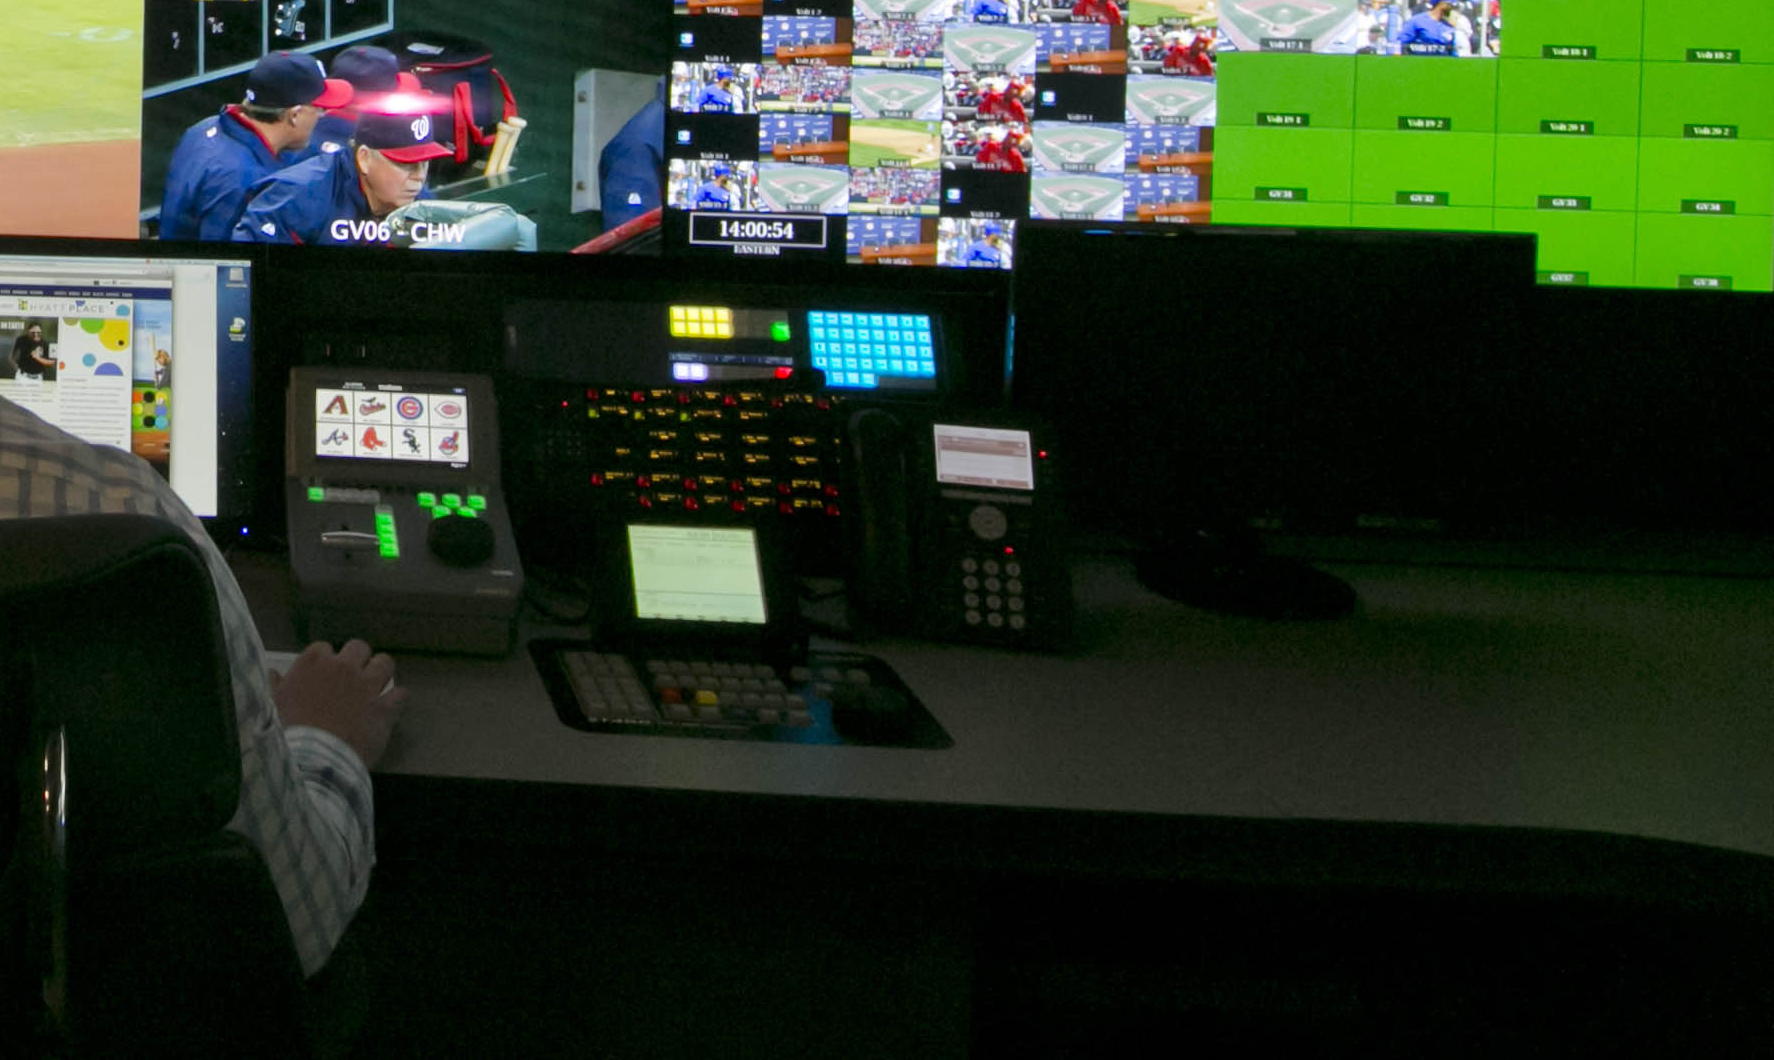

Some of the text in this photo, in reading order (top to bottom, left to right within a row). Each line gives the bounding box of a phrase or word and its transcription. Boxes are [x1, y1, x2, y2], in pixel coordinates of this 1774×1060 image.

[331, 218, 391, 242] GV06
[410, 221, 467, 245] CHW
[719, 221, 794, 239] 14:00:54
[30, 304, 105, 314] HYATT PLACE
